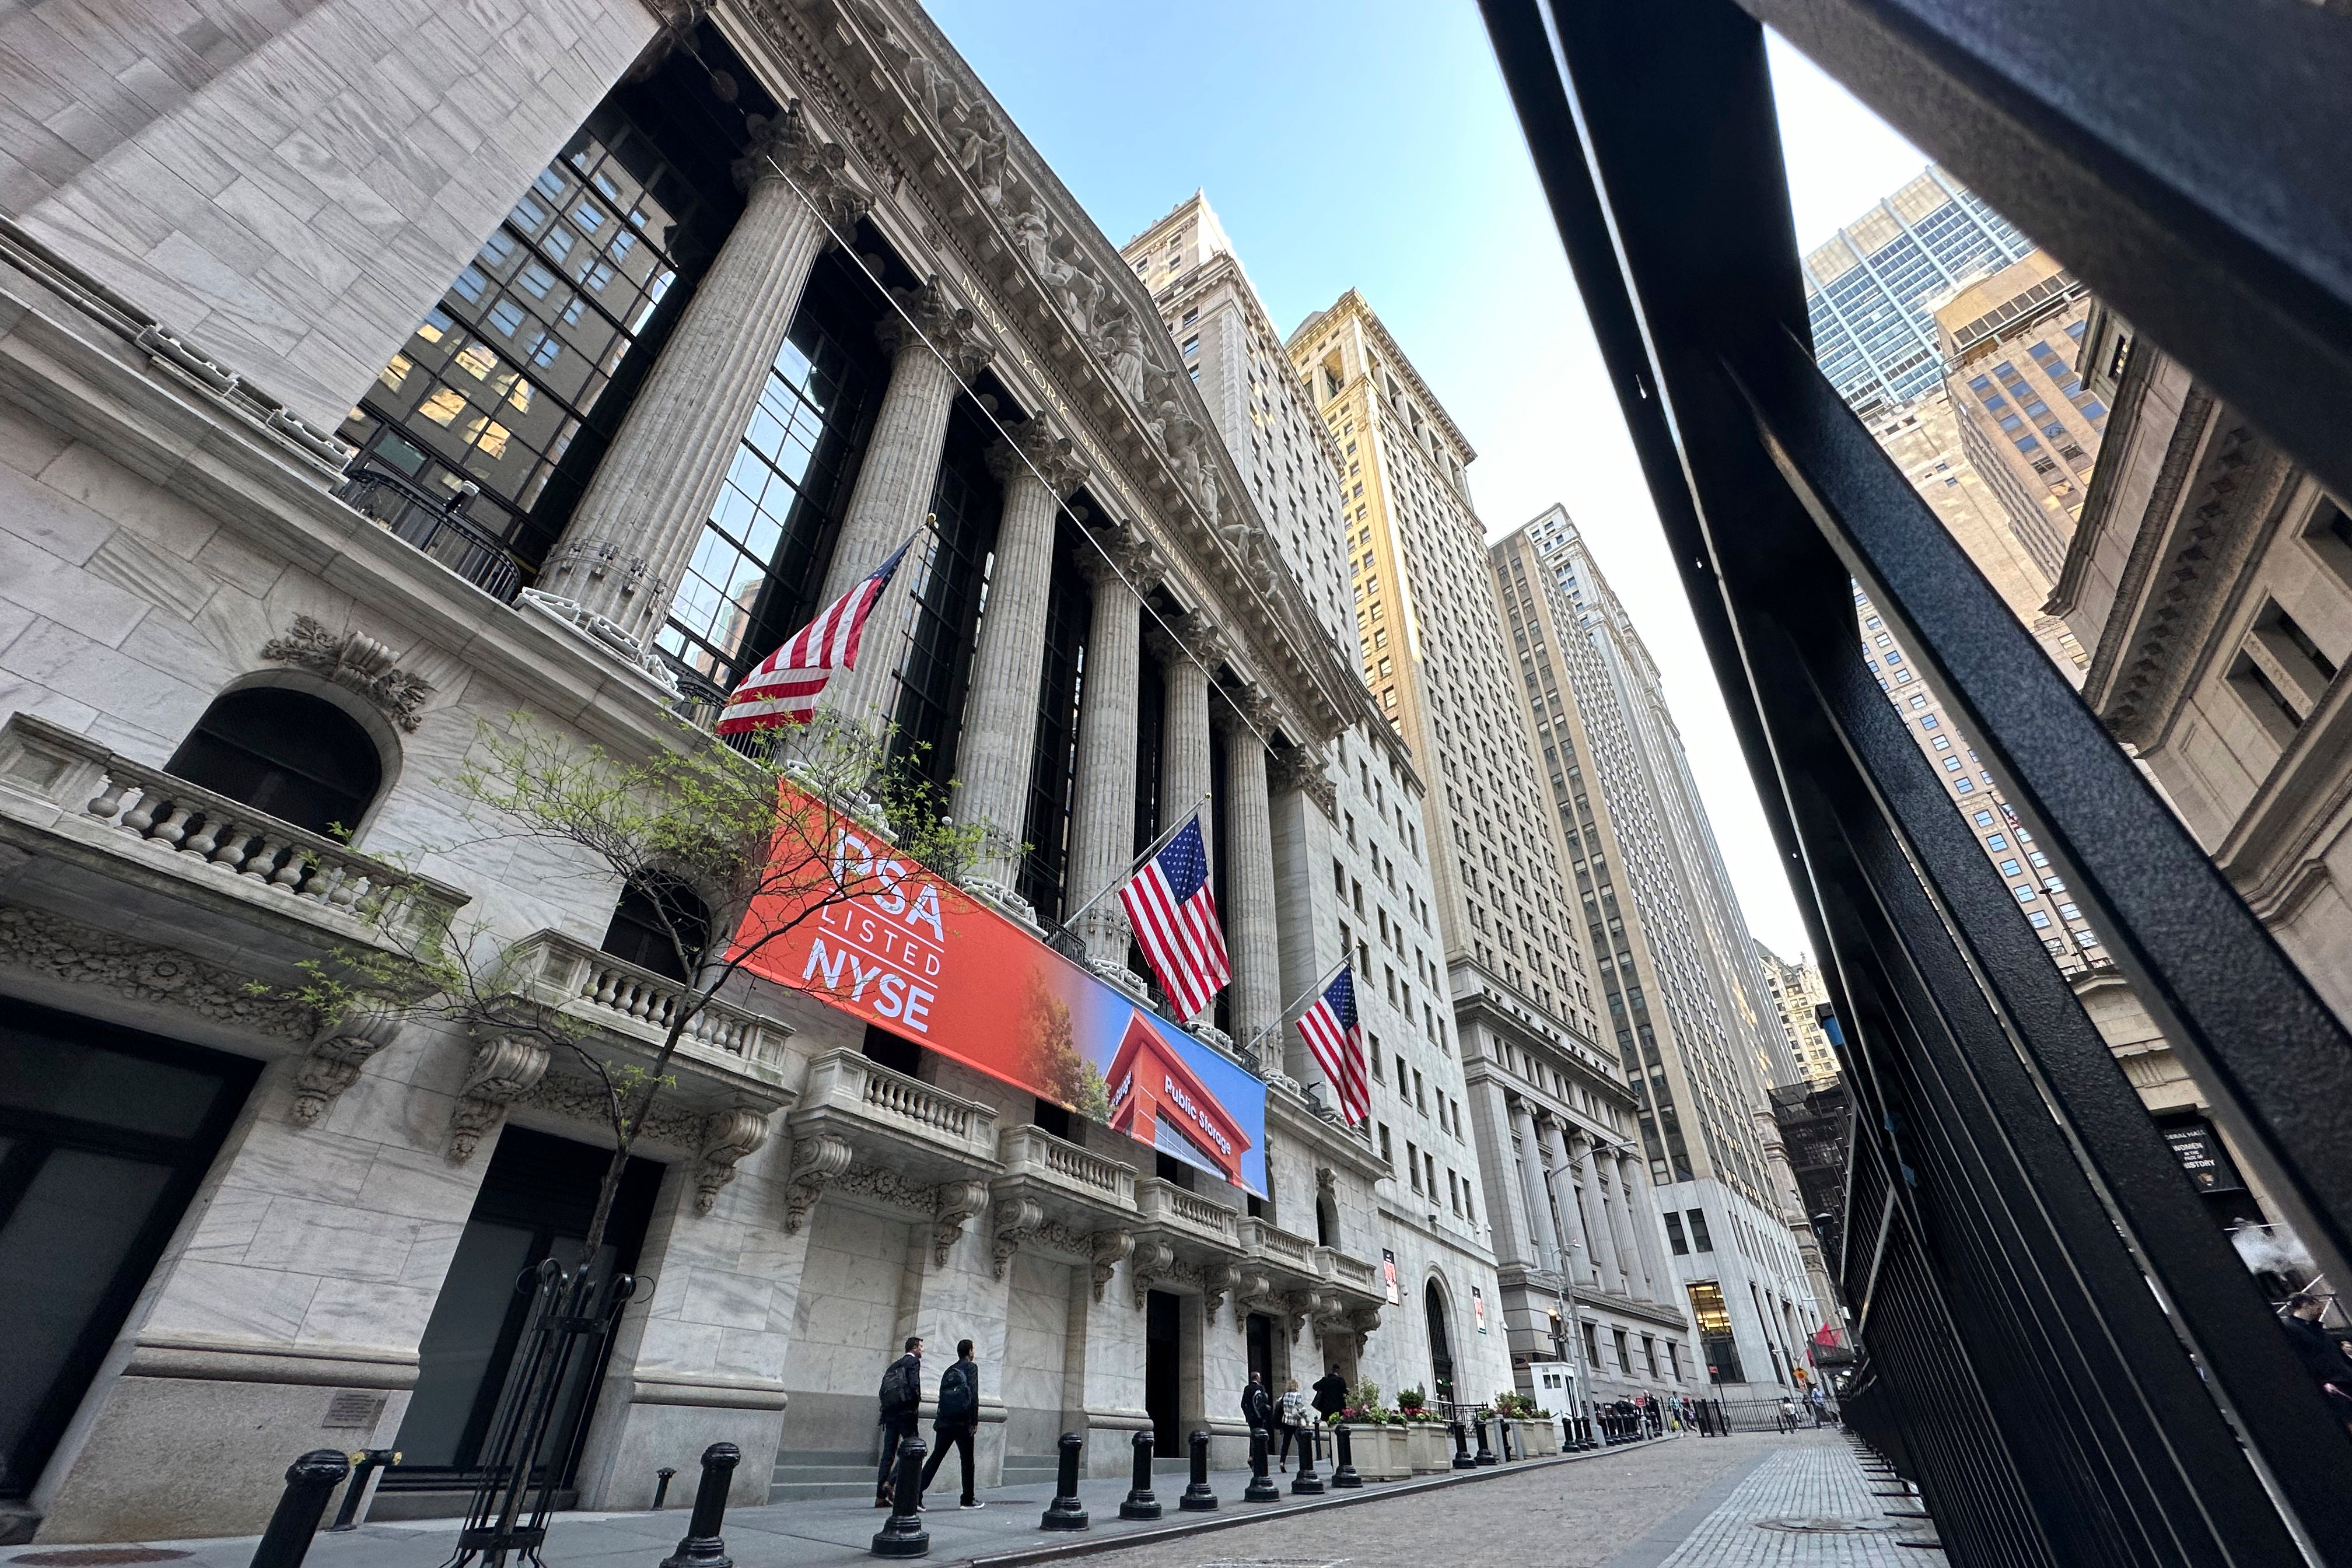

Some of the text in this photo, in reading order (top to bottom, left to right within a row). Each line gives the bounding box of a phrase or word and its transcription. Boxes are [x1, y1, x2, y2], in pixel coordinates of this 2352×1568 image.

[961, 272, 1211, 606] NEW YORK STOCK EXCHANGE
[831, 828, 944, 943] PSA
[821, 898, 940, 976] LISTED
[802, 937, 935, 1032] NYSE
[1165, 1074, 1231, 1155] Public Storage
[2172, 1142, 2203, 1152] WOMEN
[2183, 1159, 2215, 1169] HISTORY
